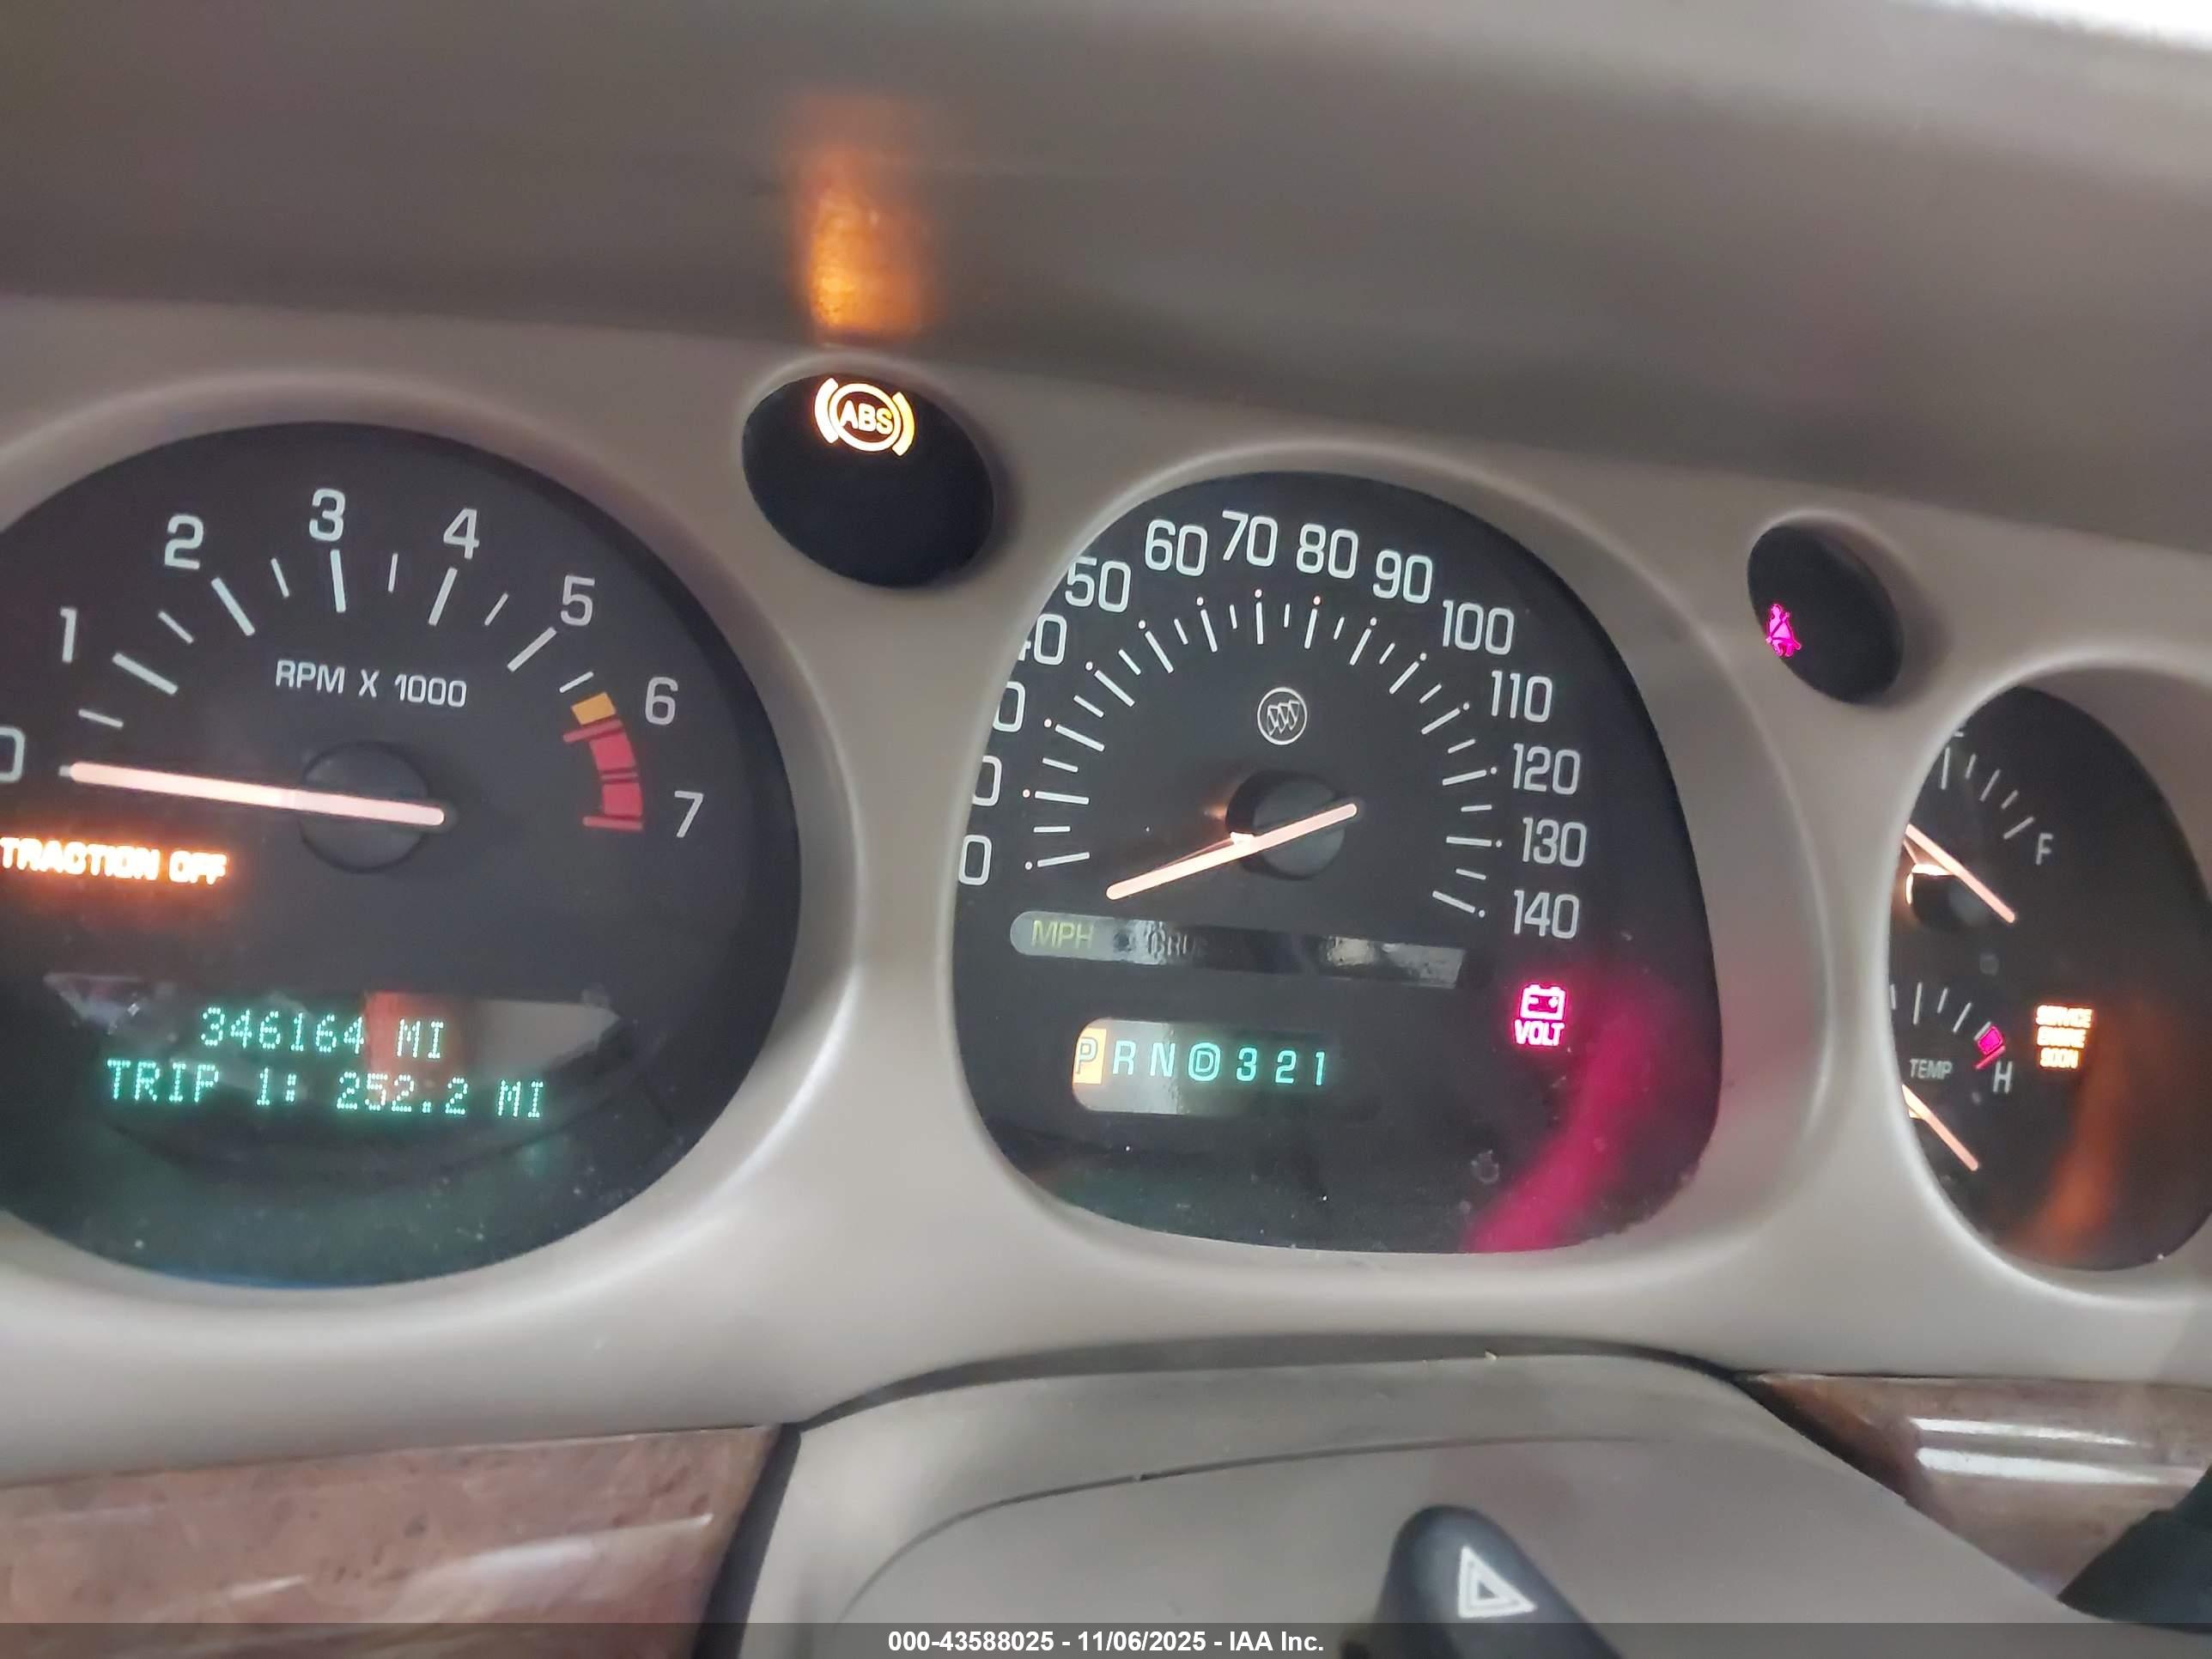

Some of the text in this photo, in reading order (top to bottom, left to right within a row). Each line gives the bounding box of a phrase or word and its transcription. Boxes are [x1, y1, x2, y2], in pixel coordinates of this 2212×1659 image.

[839, 400, 893, 434] ABS
[309, 488, 346, 541] 3
[443, 507, 480, 560] 4
[1222, 510, 1279, 567] 70
[163, 514, 204, 569] 2
[1145, 519, 1208, 577] 60
[1296, 523, 1358, 580] 80
[560, 574, 595, 626] 5
[1065, 556, 1132, 613] 50
[1372, 550, 1433, 605] 90
[60, 606, 77, 663] 1
[1442, 599, 1515, 655] 100
[275, 659, 468, 708] RPM X 1000
[644, 676, 678, 725] 6
[1491, 670, 1553, 723] 110
[1512, 743, 1580, 795] 120
[674, 790, 703, 838] 7
[0, 836, 228, 885] TRACTION OFF
[1522, 817, 1587, 867] 130
[2035, 833, 2054, 866] F
[1030, 920, 1095, 949] MPH
[1513, 890, 1580, 939] 140
[200, 1007, 446, 1060] 346164 MI
[1514, 1018, 1565, 1047] VOLT
[1075, 1036, 1099, 1075] P
[1112, 1040, 1137, 1075] R
[1149, 1042, 1176, 1079] N
[1236, 1046, 1259, 1082] 3
[1274, 1049, 1297, 1085] 2
[1315, 1050, 1326, 1086] 1
[1909, 1059, 1954, 1080] TEMP
[1992, 1060, 2014, 1094] H
[106, 1058, 219, 1103] TRIP
[336, 1071, 469, 1115] 252.2
[496, 1079, 544, 1119] MI
